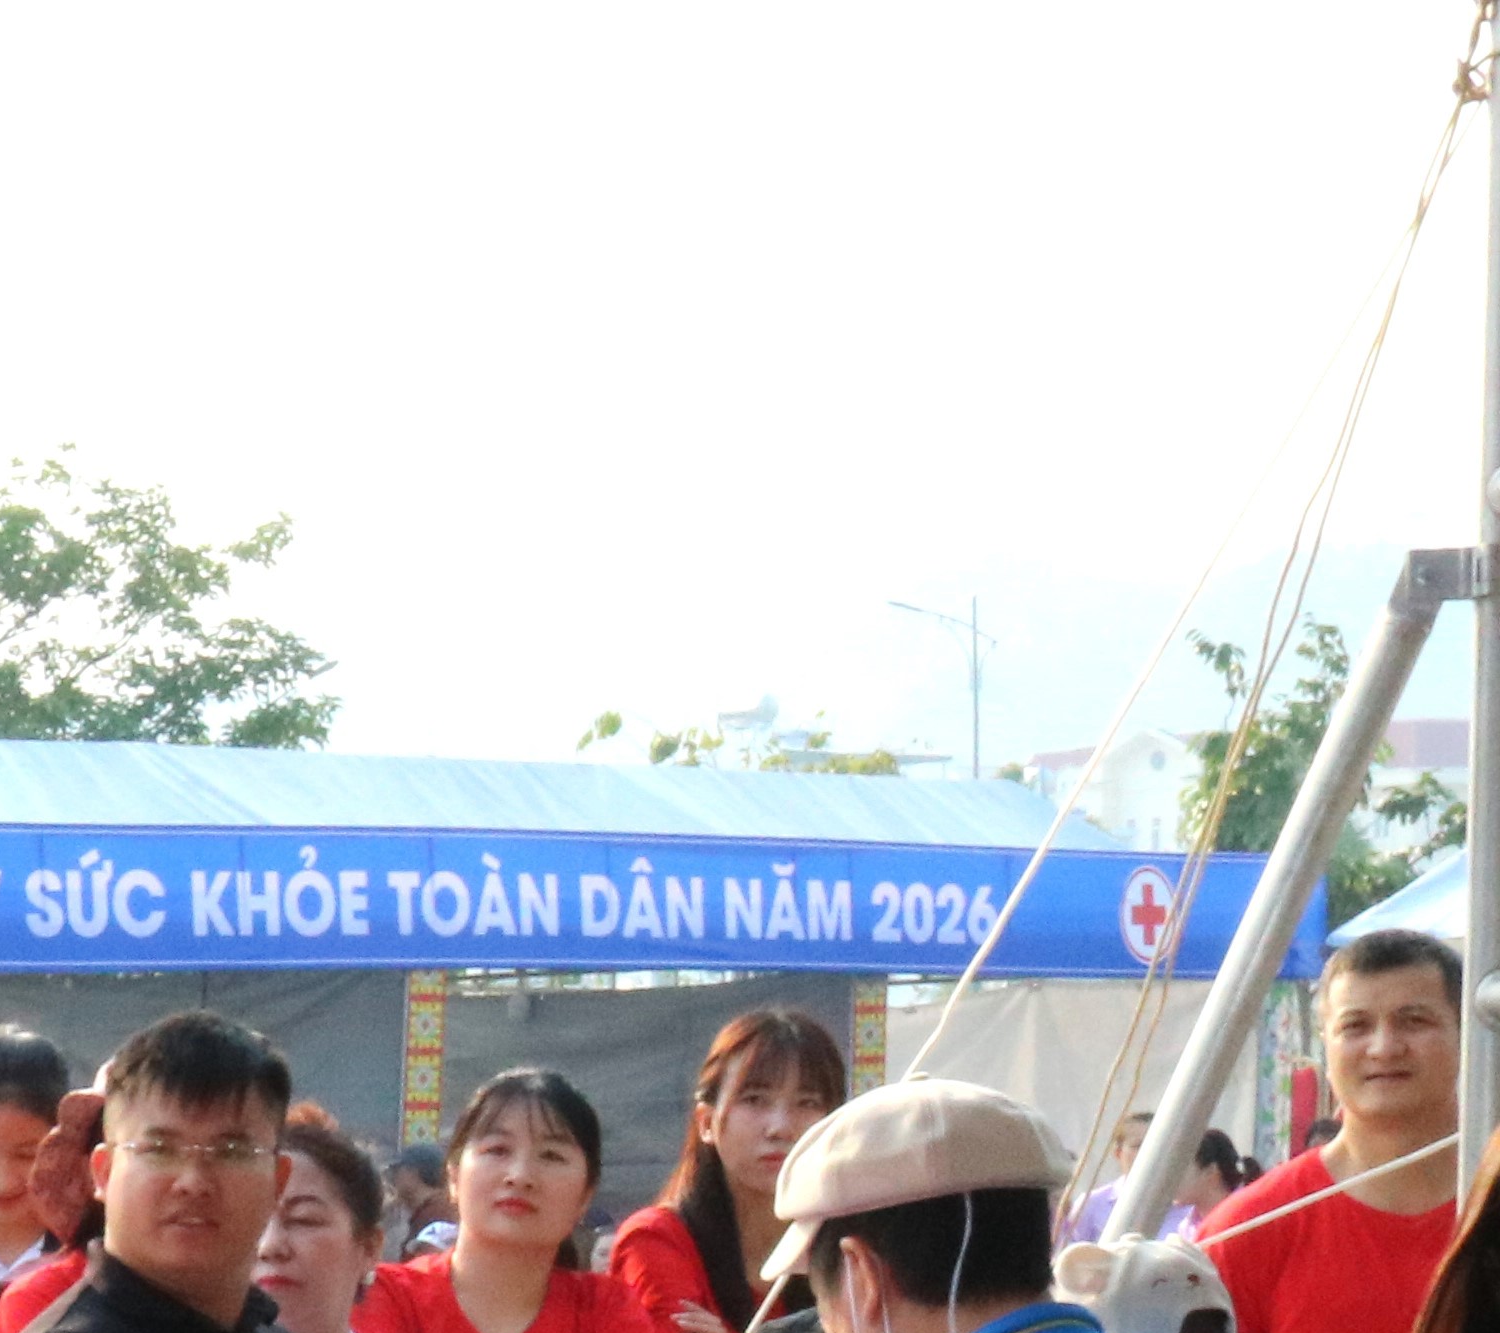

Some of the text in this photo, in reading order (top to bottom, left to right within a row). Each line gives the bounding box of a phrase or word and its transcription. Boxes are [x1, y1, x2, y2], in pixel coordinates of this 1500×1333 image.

[24, 848, 166, 937] SỨC
[190, 844, 370, 937] KHỎE
[386, 852, 560, 936] TOÀN
[579, 856, 705, 938] DÂN
[723, 863, 853, 940] NĂM
[871, 881, 997, 945] 2026
